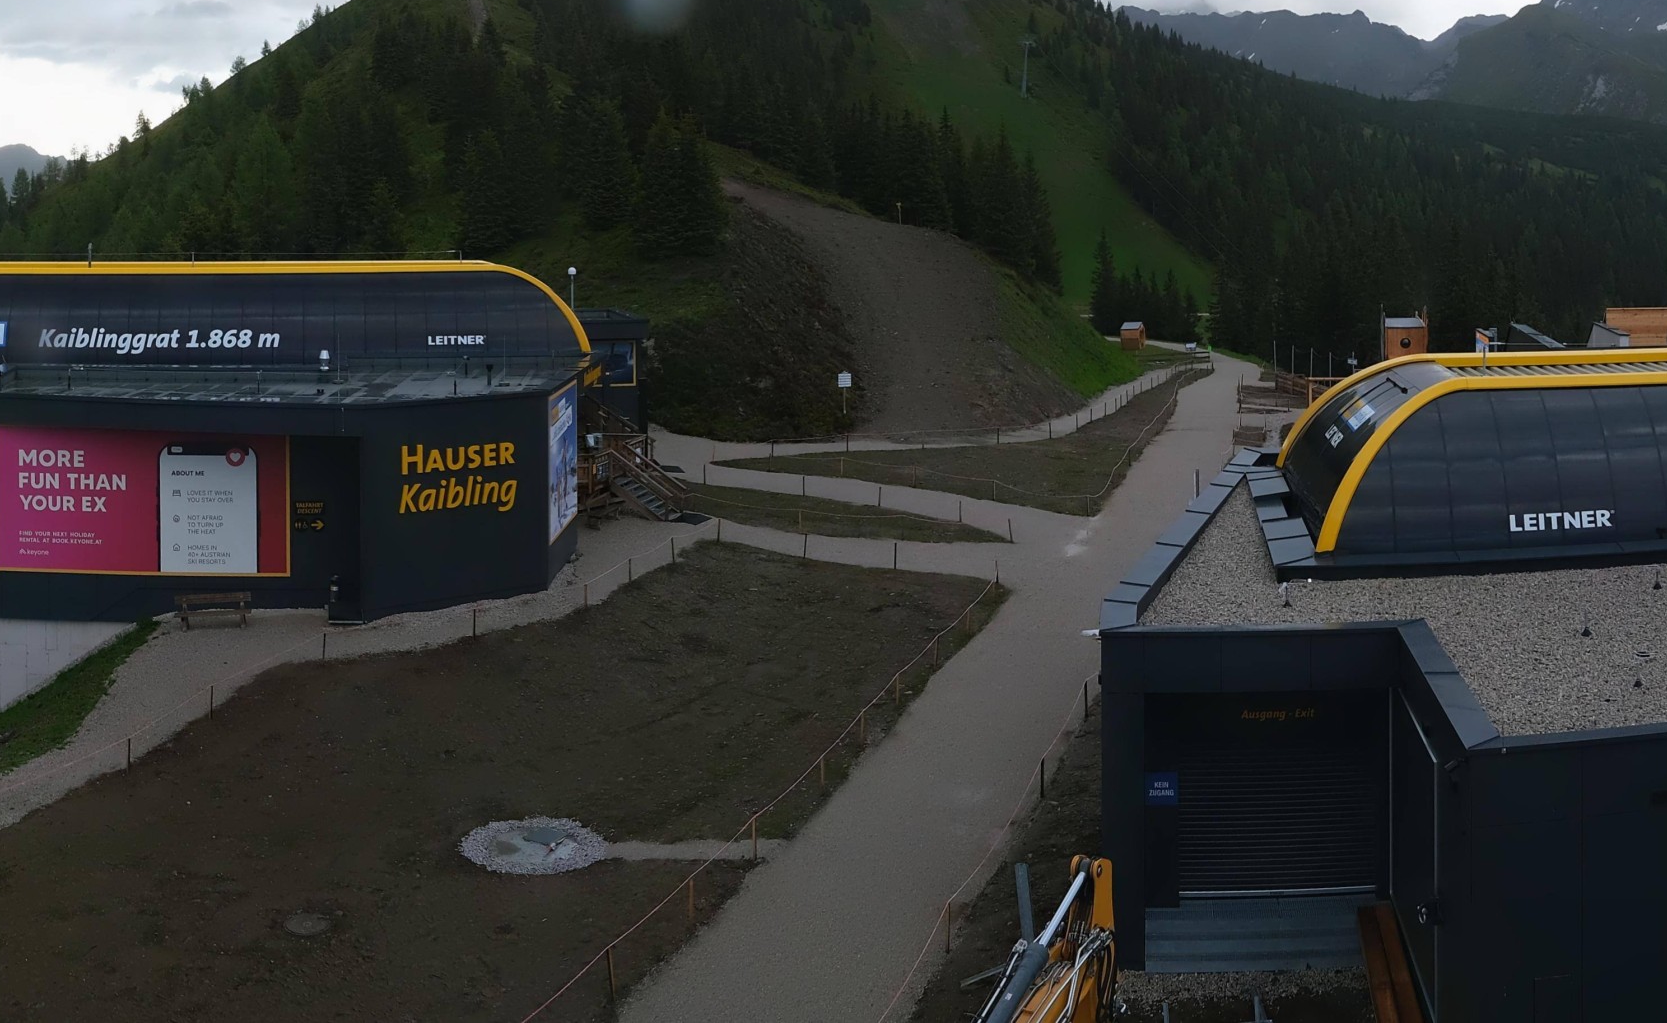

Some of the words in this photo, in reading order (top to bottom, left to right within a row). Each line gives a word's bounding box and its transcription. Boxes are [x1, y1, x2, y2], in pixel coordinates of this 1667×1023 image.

[38, 328, 180, 355] Kaiblinggrat
[185, 329, 252, 348] 1.868
[258, 333, 280, 348] m
[428, 335, 484, 345] LEITNER
[18, 449, 85, 467] MORE
[401, 441, 516, 475] HAUSER
[18, 472, 60, 489] FUN
[67, 473, 127, 490] THAN
[20, 495, 75, 511] YOUR
[81, 496, 107, 512] EX
[399, 475, 518, 514] Kaibling
[1509, 510, 1613, 532] LEITNER
[1241, 709, 1287, 721] Ausgang
[1295, 708, 1315, 718] Exit
[1149, 789, 1175, 797] ZUGANG
